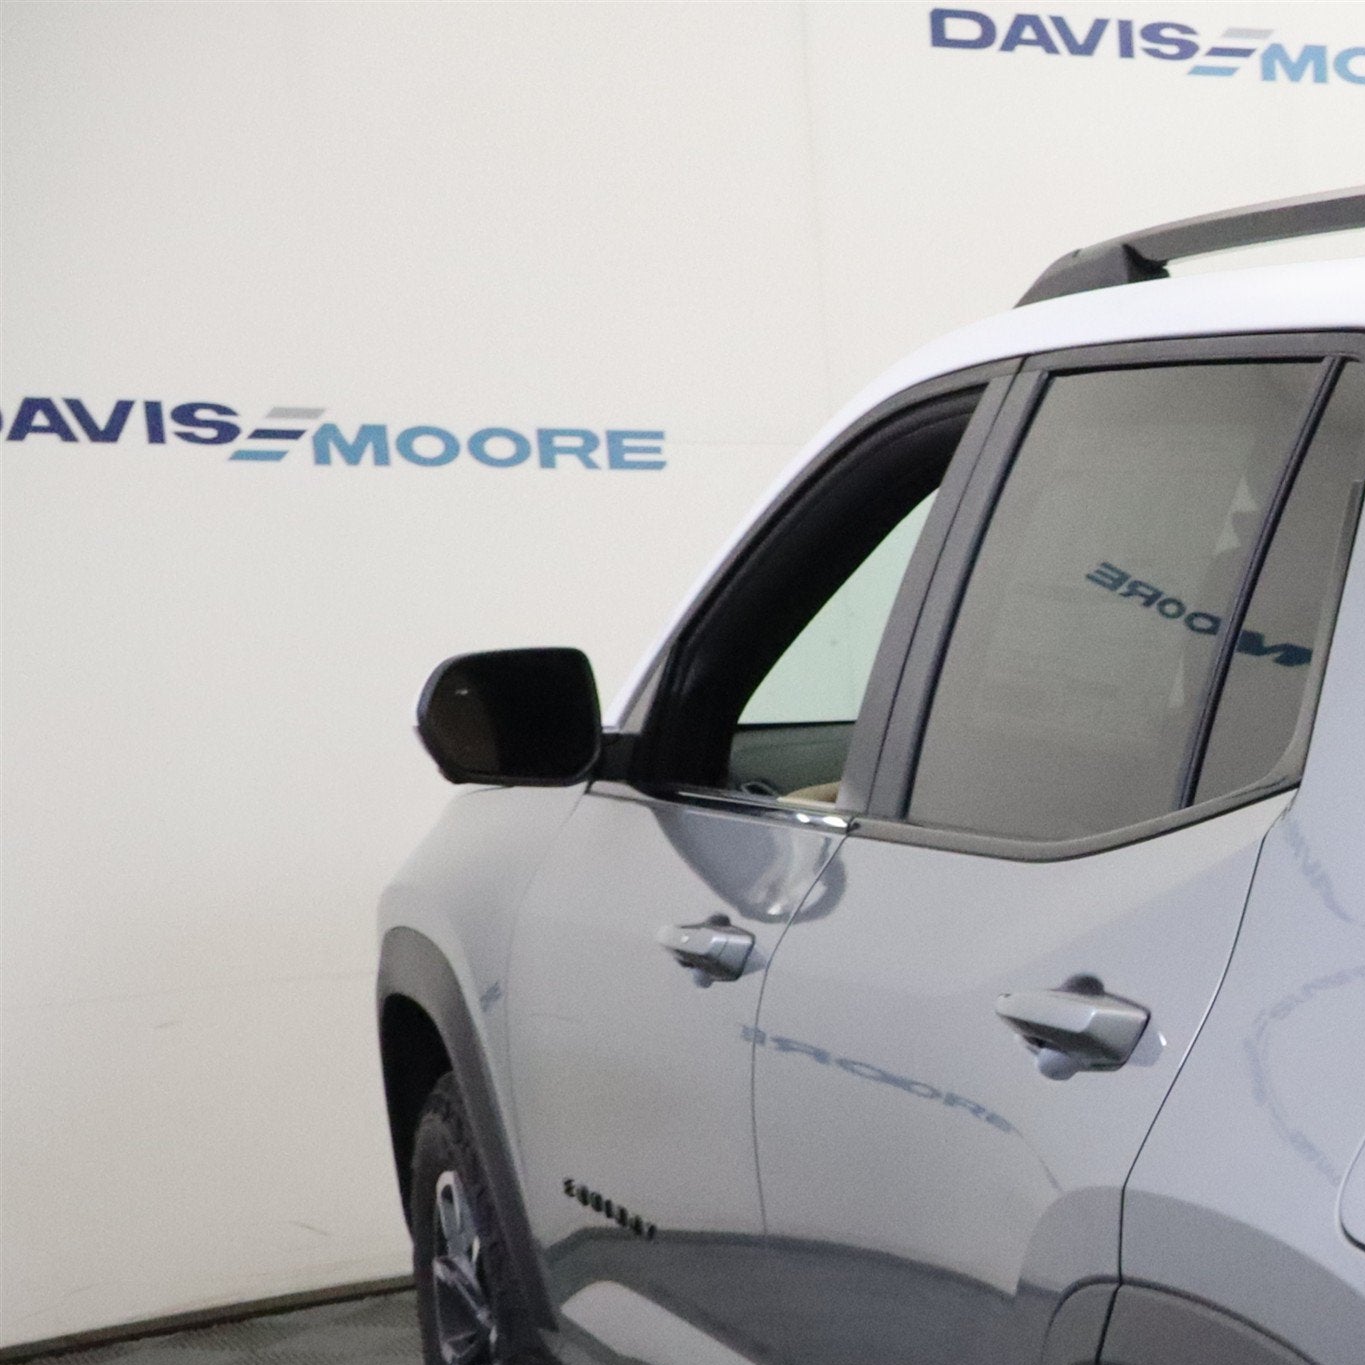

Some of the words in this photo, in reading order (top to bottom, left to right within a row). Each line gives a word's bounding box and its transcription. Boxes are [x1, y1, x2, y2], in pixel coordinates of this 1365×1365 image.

[929, 8, 1200, 62] DAVIS
[0, 396, 241, 445] AVIS
[312, 422, 667, 471] MOORE
